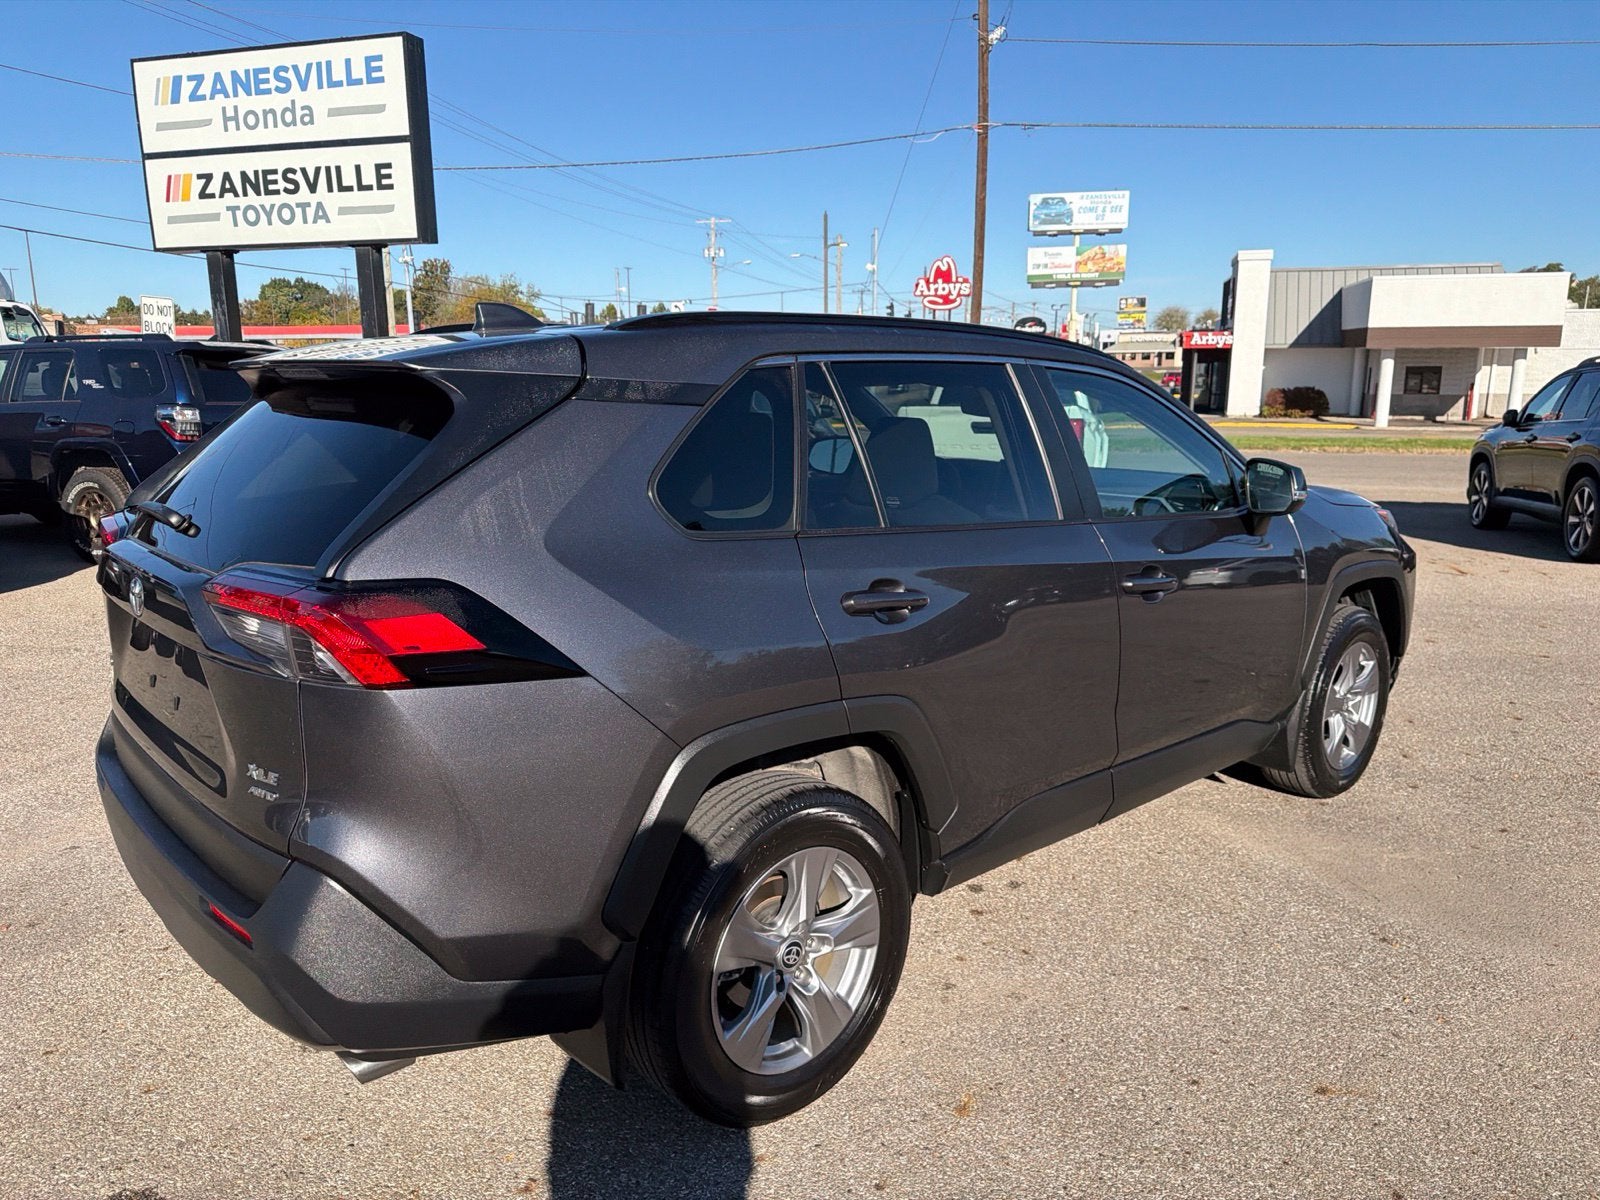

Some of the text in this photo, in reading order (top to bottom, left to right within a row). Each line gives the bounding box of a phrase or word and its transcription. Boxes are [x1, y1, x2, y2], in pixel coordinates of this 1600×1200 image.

[187, 54, 385, 102] ZANESVILLE
[221, 99, 314, 132] Honda
[196, 162, 394, 199] ZANESVILLE
[226, 201, 331, 228] TOYOTA
[1078, 205, 1100, 214] COME
[1110, 204, 1124, 213] SEE
[914, 278, 970, 300] Arby's
[143, 303, 172, 317] DO NOT
[144, 321, 174, 334] BLOCK
[1190, 331, 1233, 348] Arby's
